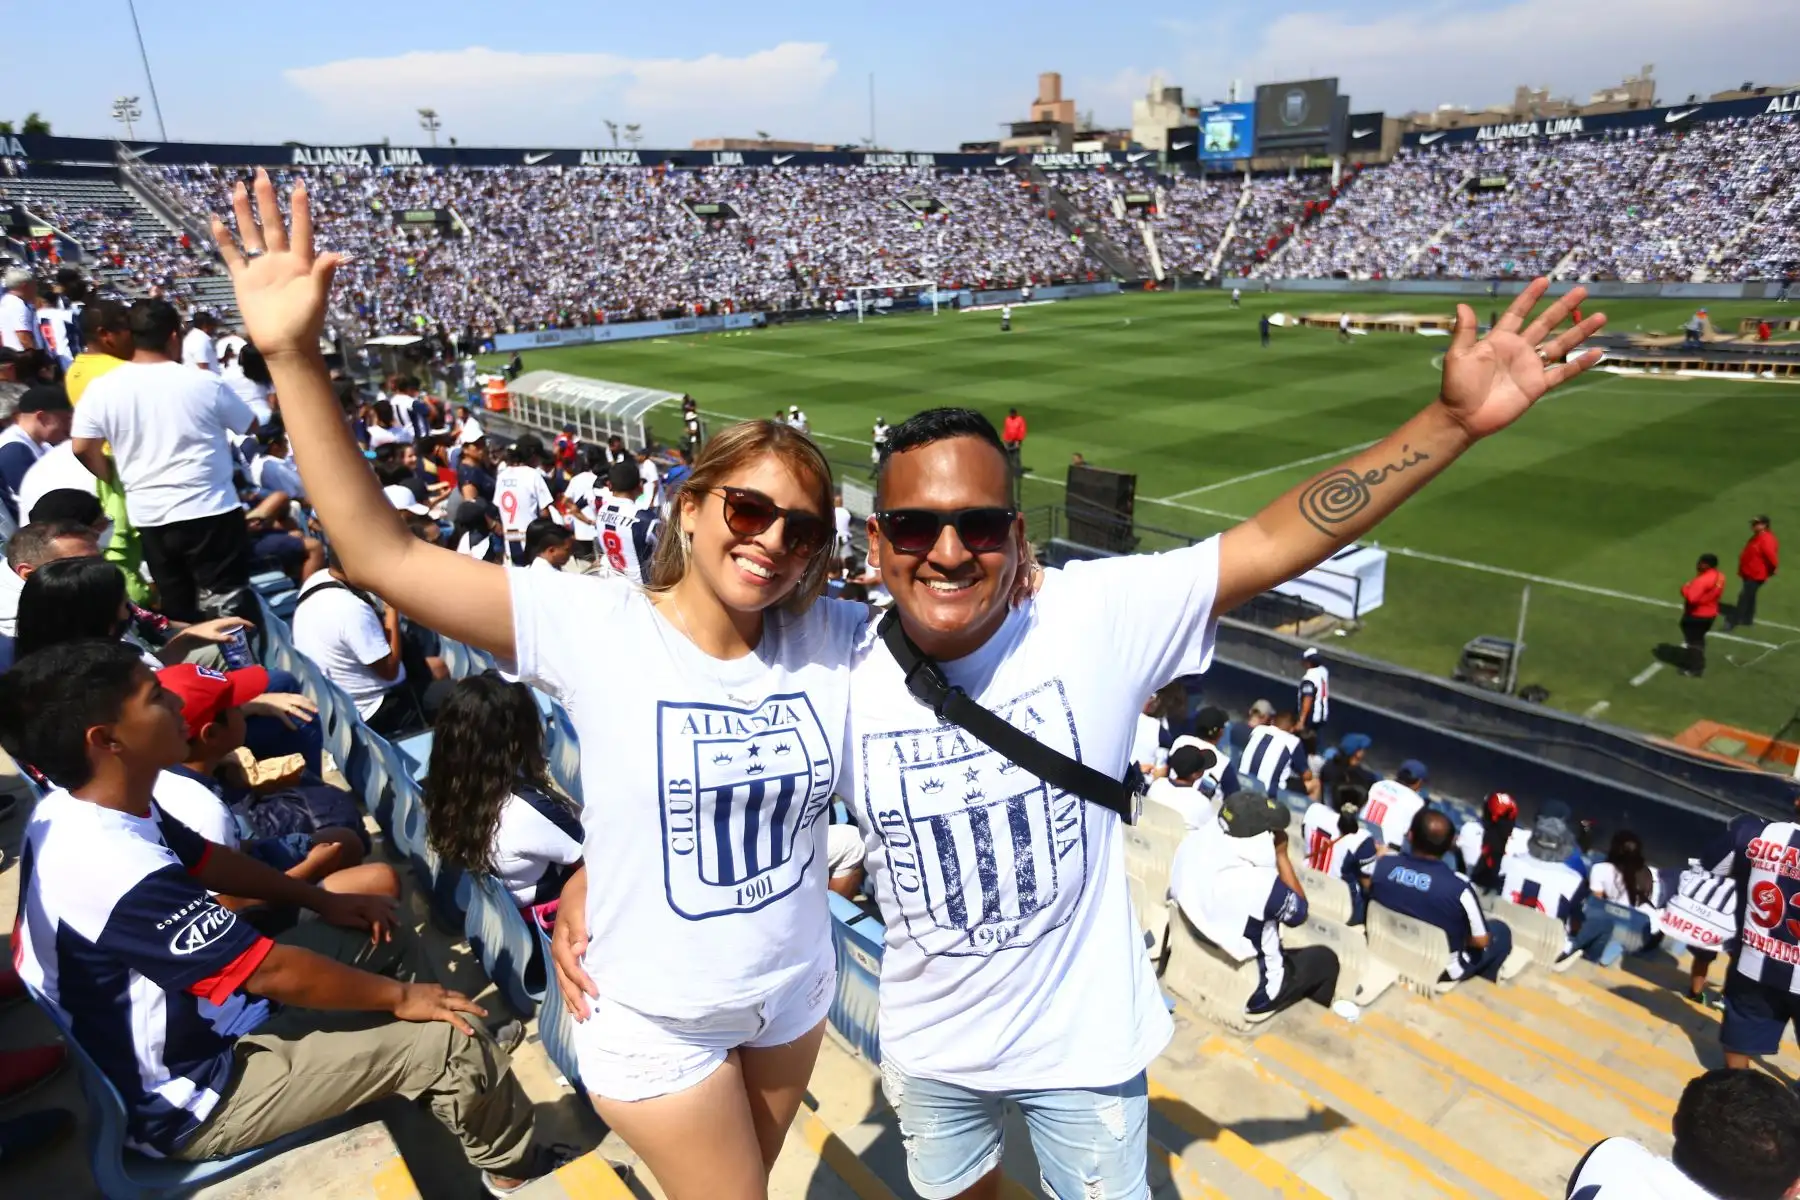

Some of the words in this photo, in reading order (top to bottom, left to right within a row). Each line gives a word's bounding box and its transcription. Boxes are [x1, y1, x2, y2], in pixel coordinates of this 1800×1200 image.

[1764, 94, 1800, 114] ALI
[1475, 122, 1539, 142] ALIANZA
[1544, 117, 1583, 135] LIMA
[292, 147, 375, 166] ALIANZA
[378, 148, 423, 166] LIMA
[579, 151, 641, 166] ALIANZA
[712, 151, 745, 166] LIMA
[501, 490, 518, 524] 9
[602, 531, 627, 571] 8
[887, 704, 1047, 766] ALIAA
[800, 758, 830, 830] LIMA
[668, 778, 695, 856] CLUB
[1051, 785, 1081, 862] IMA
[878, 808, 920, 893] CLUB
[1745, 837, 1800, 868] SICA
[735, 875, 774, 905] 1901
[965, 924, 1023, 949] 1901
